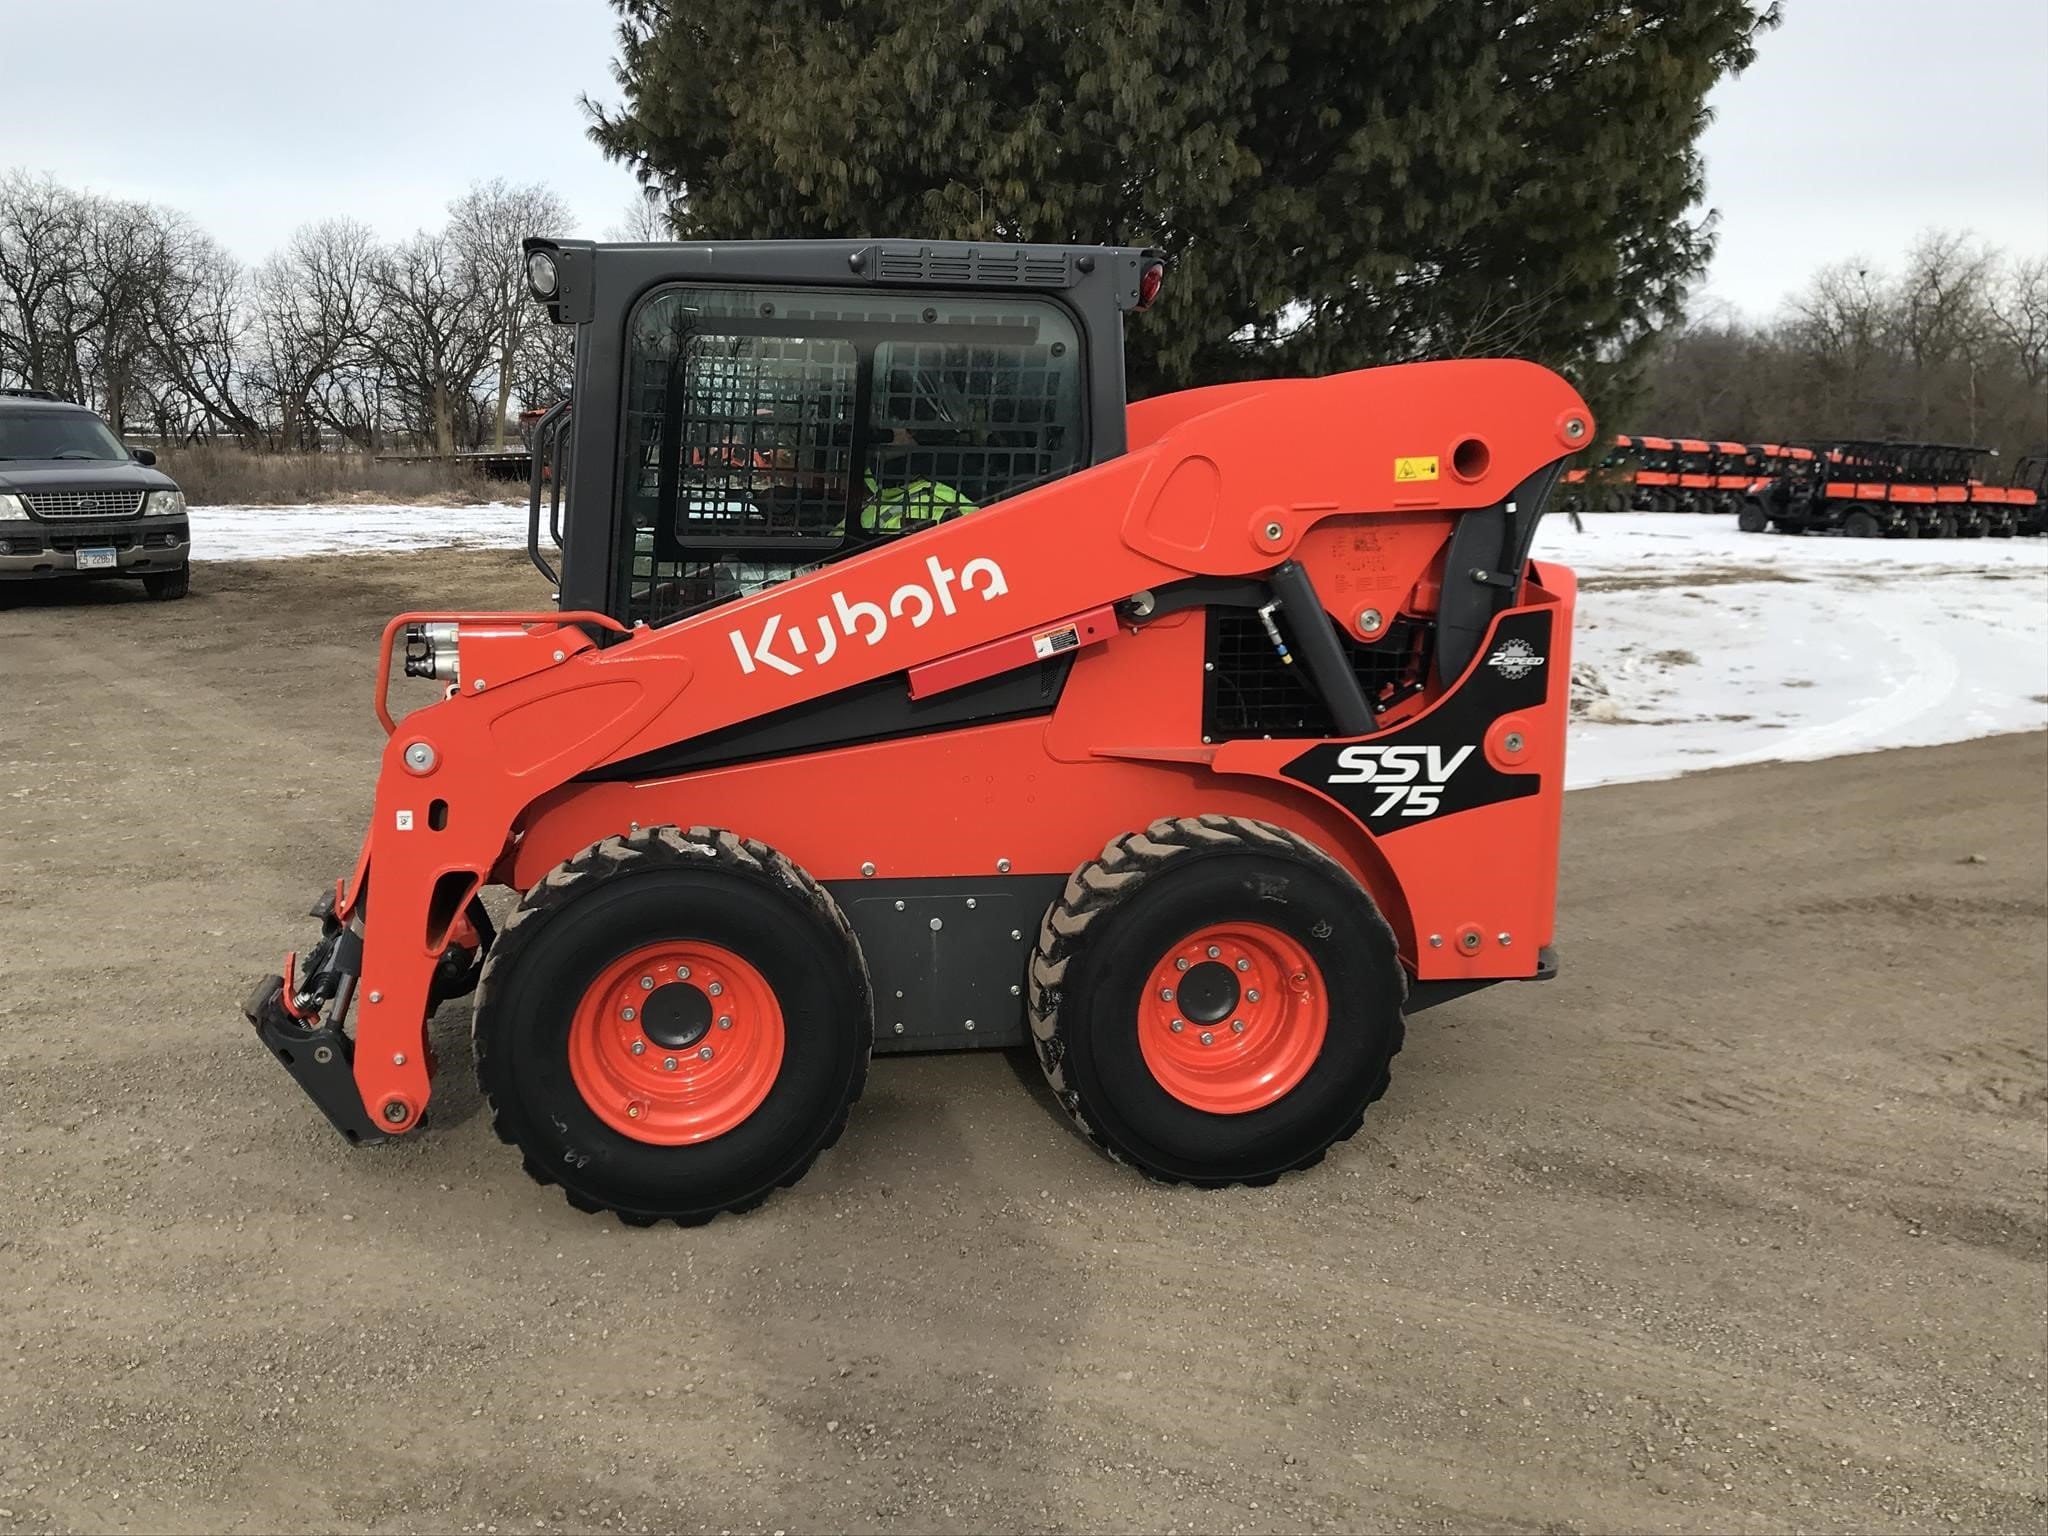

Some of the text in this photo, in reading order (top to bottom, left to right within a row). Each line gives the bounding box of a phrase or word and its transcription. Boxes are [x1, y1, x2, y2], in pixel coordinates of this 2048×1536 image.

[729, 555, 1008, 676] Kubota
[1328, 745, 1477, 783] SSV
[1370, 785, 1445, 817] 75
